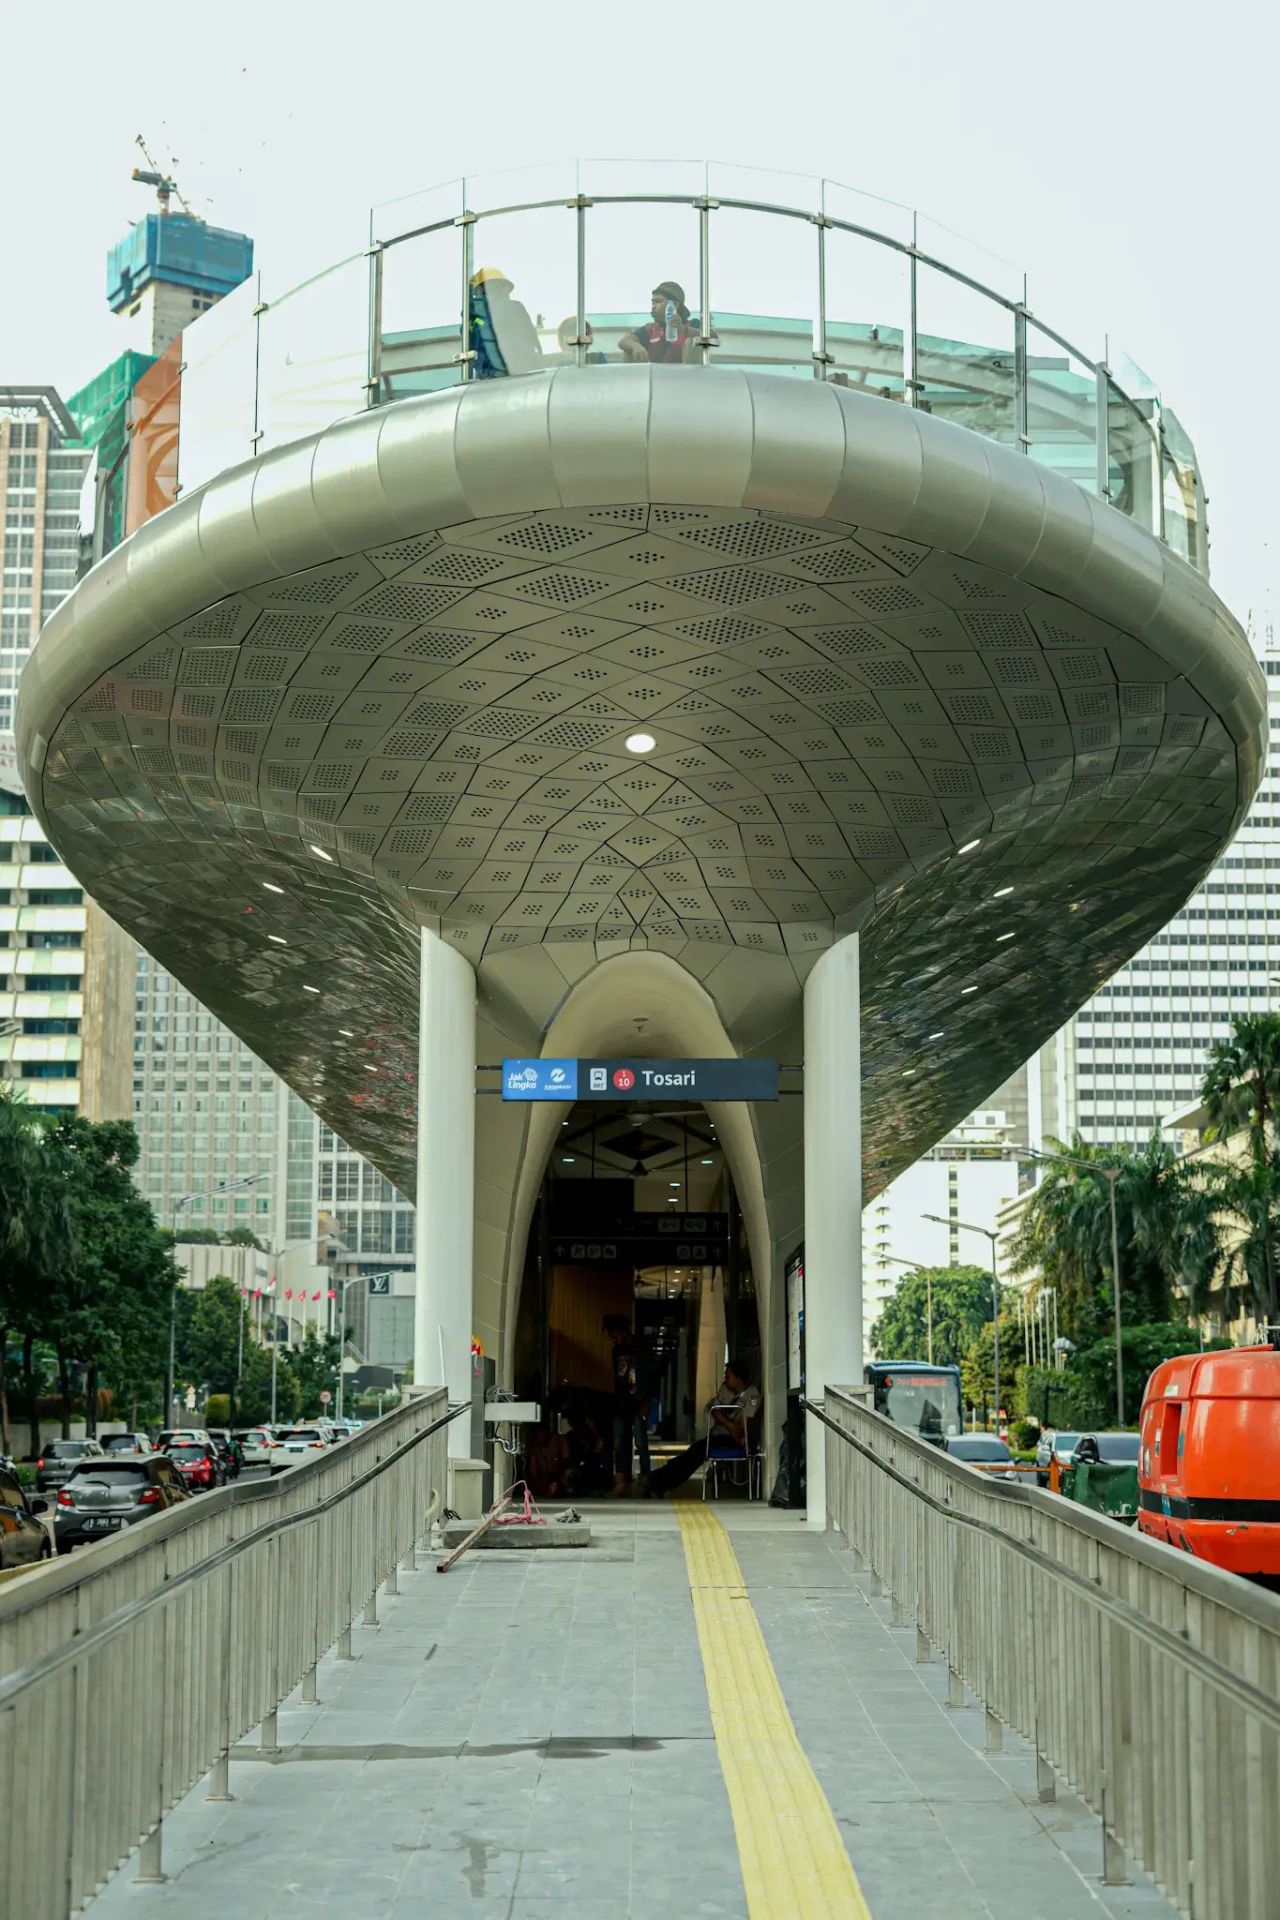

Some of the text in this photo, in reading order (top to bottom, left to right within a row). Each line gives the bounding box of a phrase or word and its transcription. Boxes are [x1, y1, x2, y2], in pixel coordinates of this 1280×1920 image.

[619, 1078, 630, 1087] 10
[642, 1070, 696, 1086] Tosari
[508, 1080, 537, 1091] Lingko
